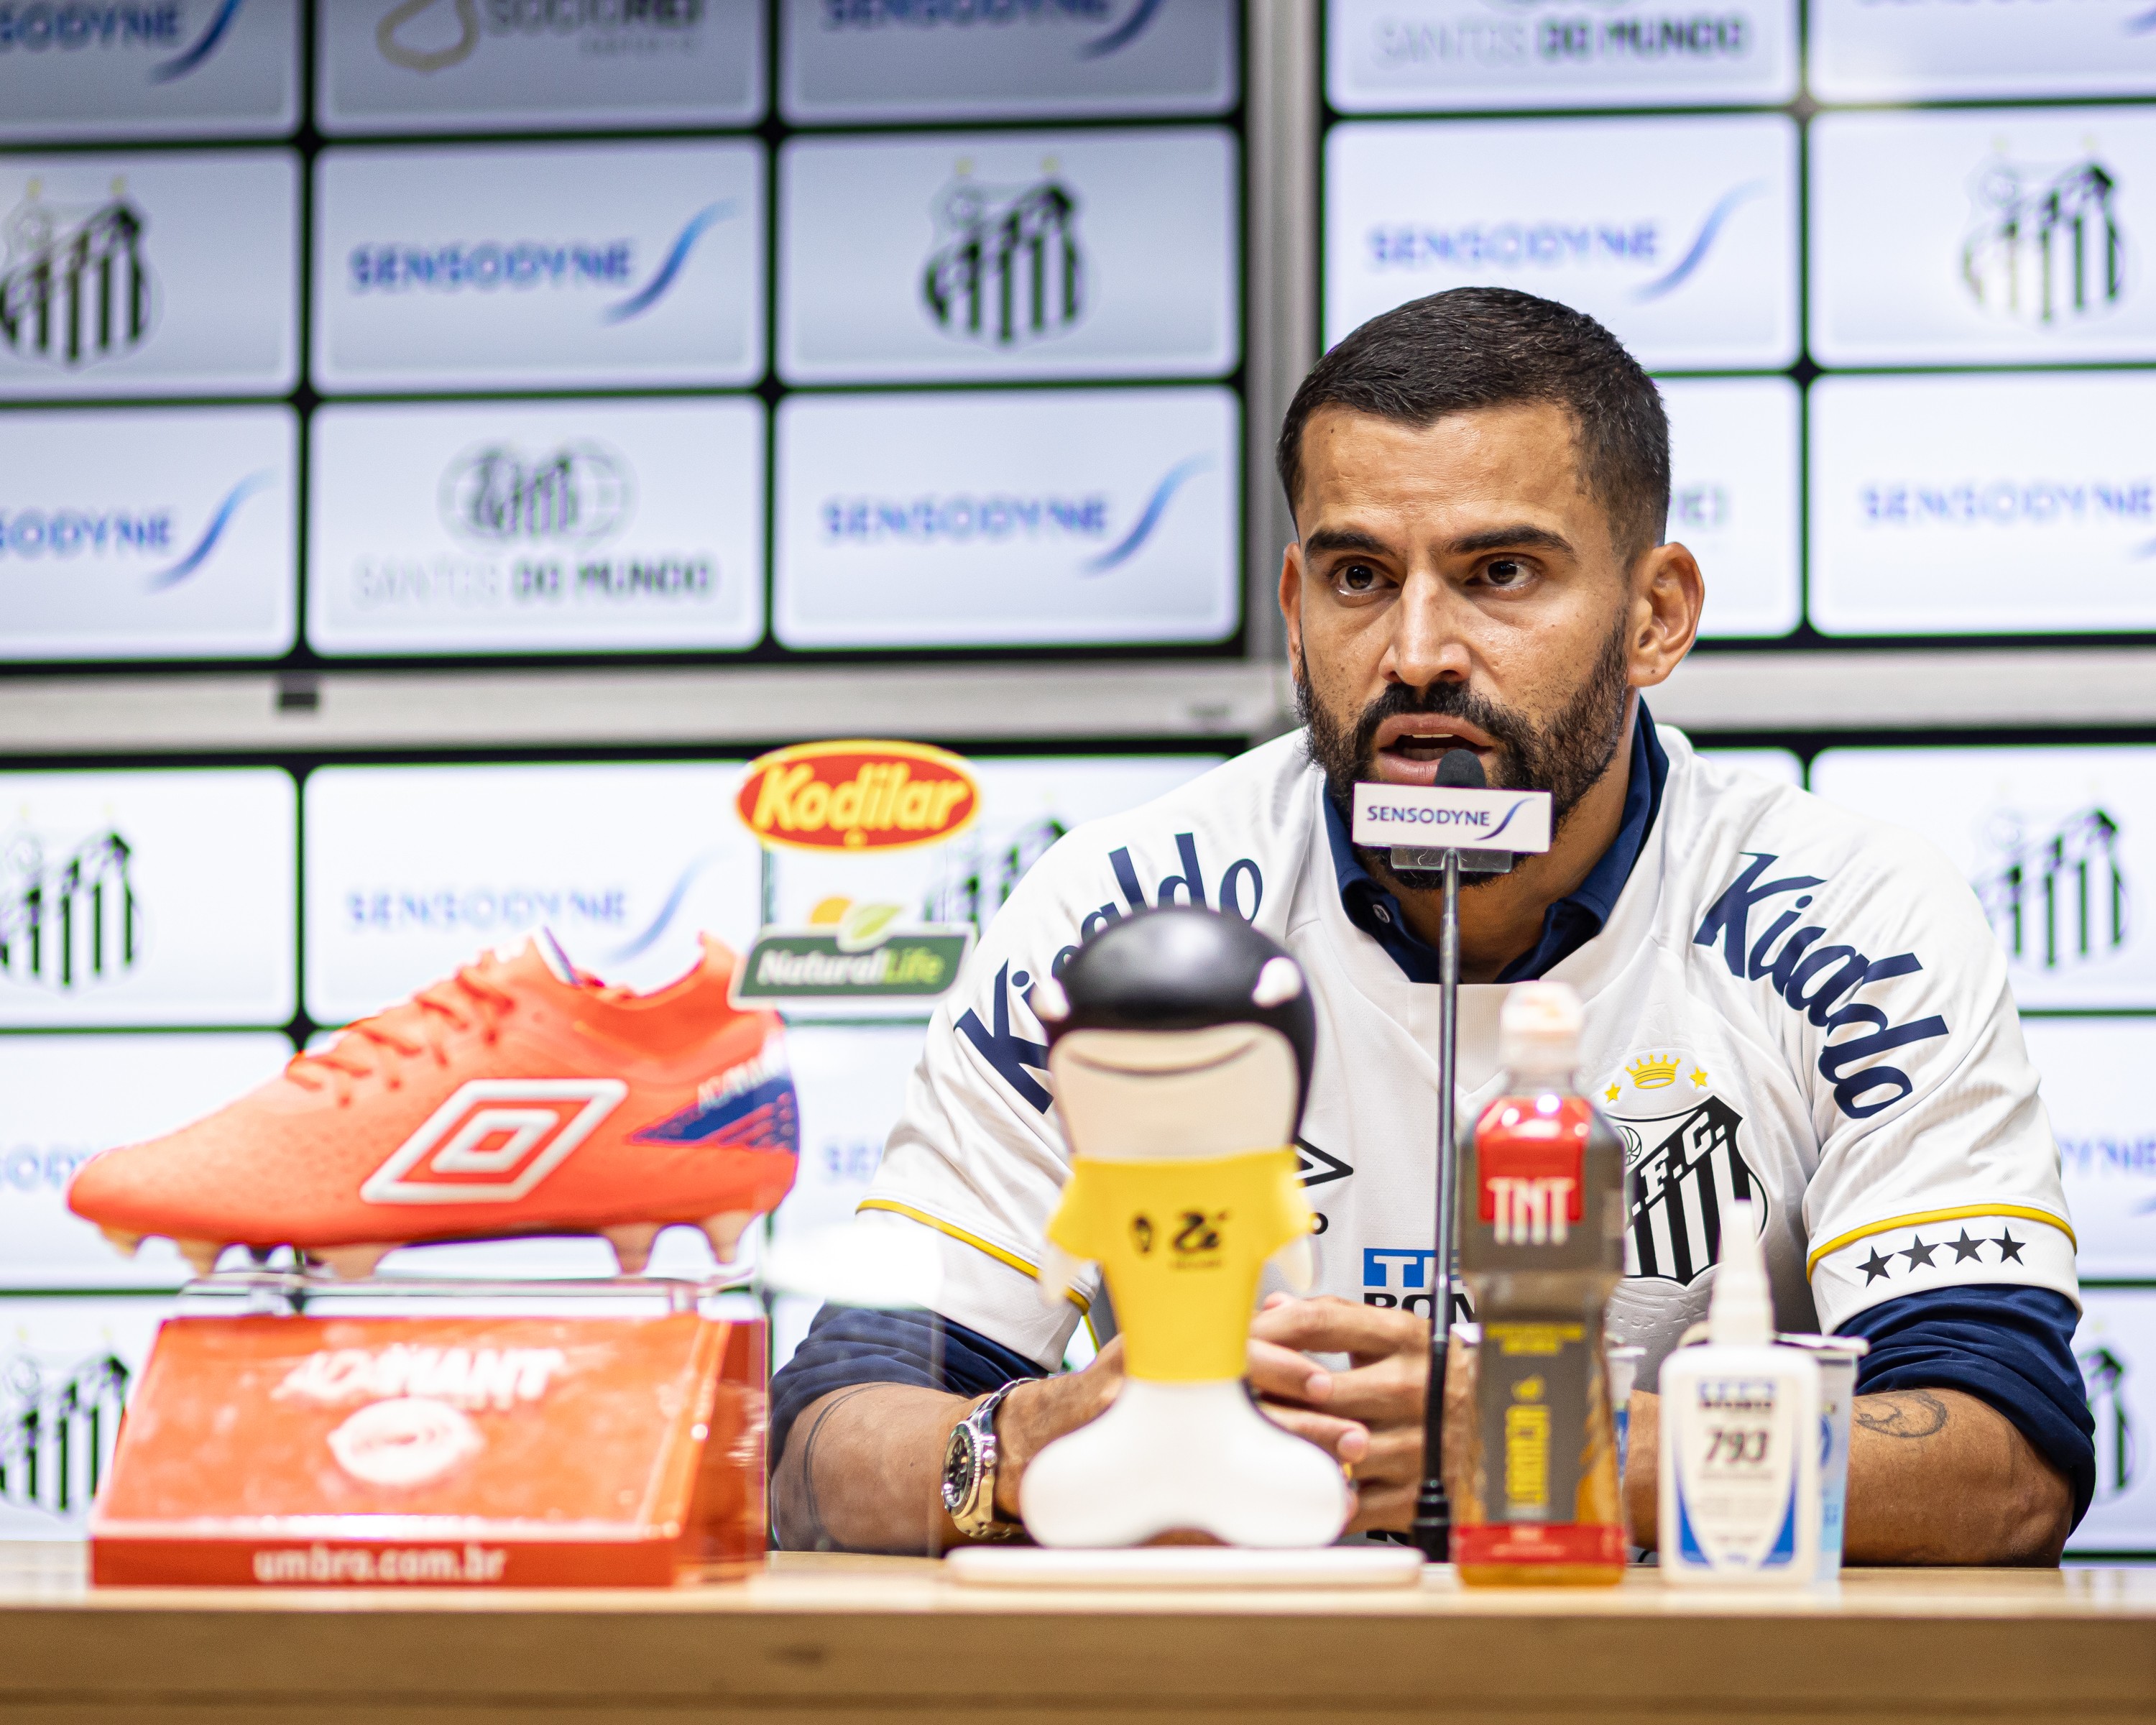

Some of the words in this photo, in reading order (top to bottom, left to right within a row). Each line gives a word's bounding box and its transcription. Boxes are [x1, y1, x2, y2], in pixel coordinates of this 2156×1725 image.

[352, 242, 631, 290] SENSODYNE
[1369, 222, 1659, 267] SENSODYNE
[824, 495, 1108, 543] SENSODYNE
[752, 762, 968, 832] Kodilar
[1367, 804, 1491, 827] SENSODYNE
[347, 889, 630, 931] SENSODYNE
[1486, 1176, 1576, 1246] TNT
[253, 1541, 506, 1581] umbro.com.br
